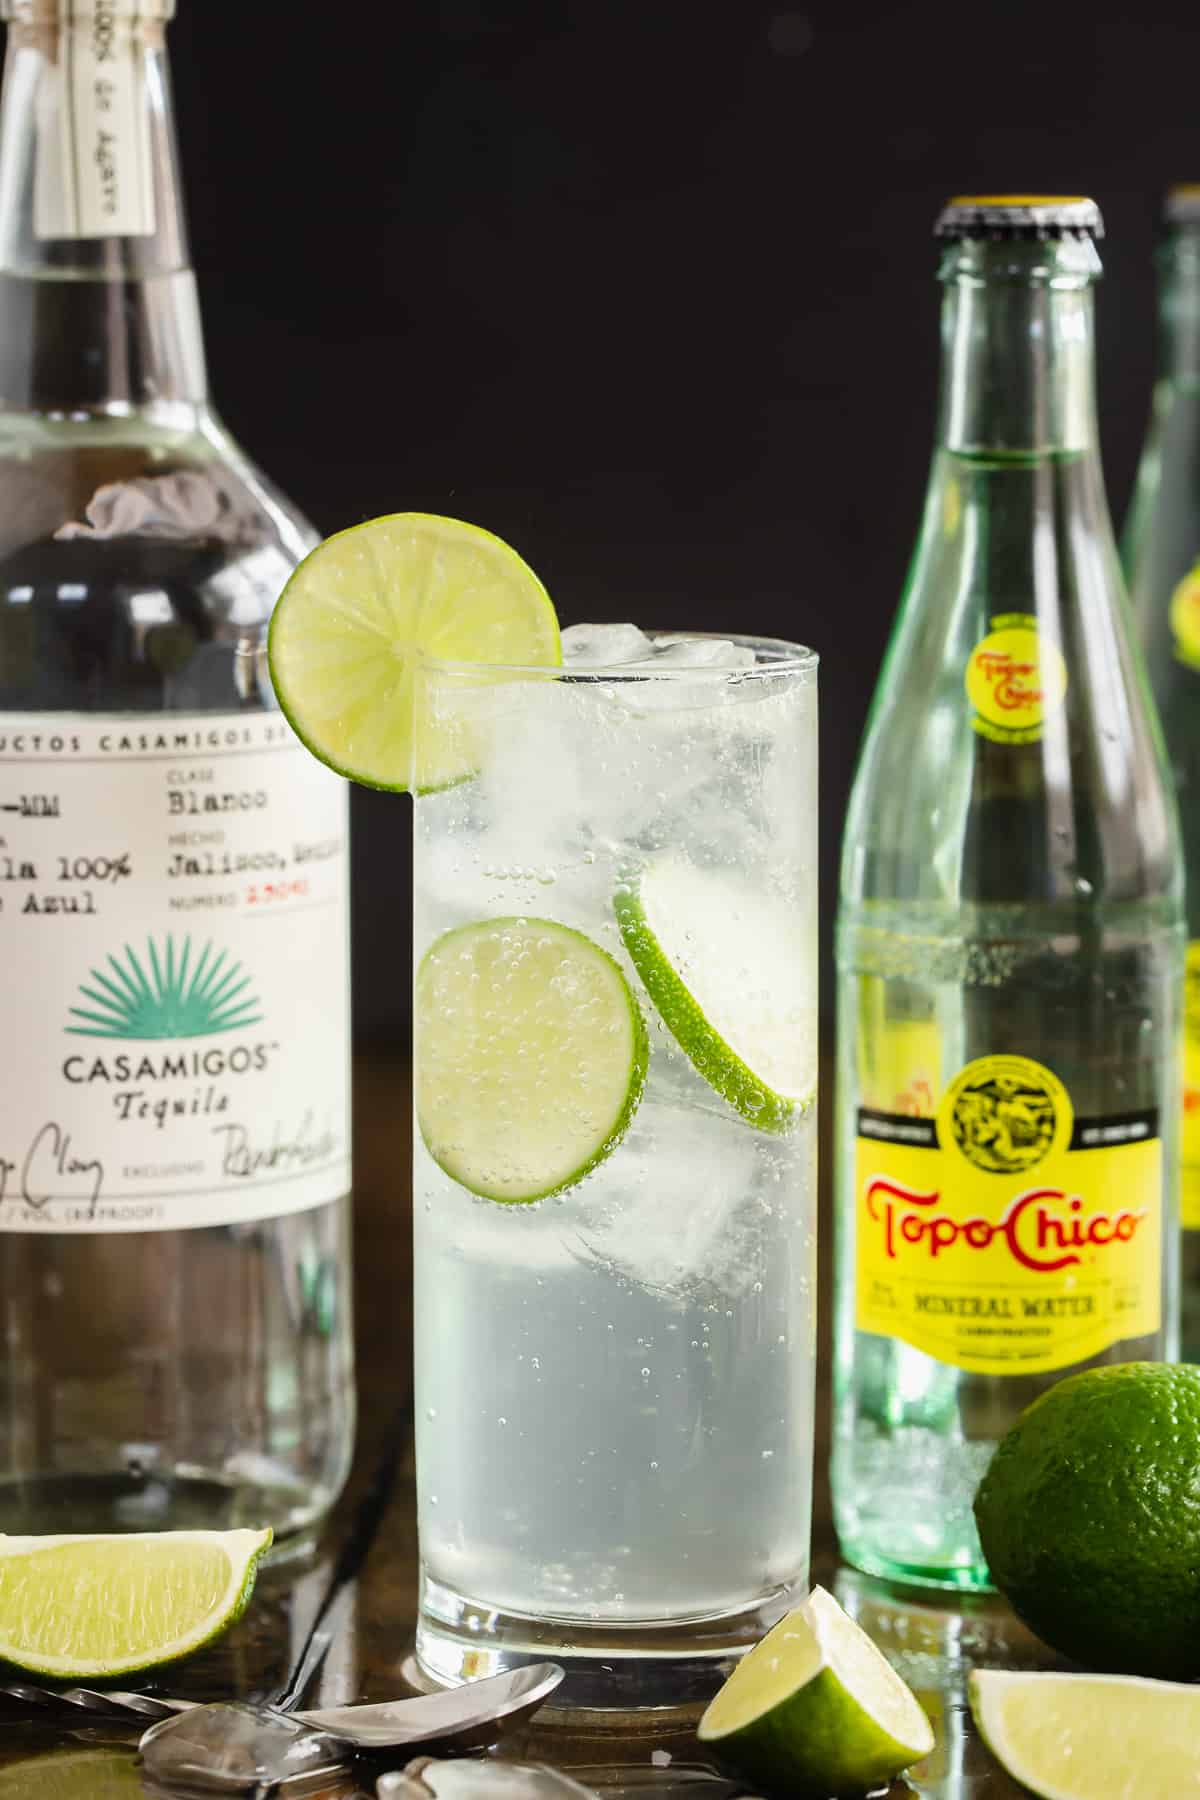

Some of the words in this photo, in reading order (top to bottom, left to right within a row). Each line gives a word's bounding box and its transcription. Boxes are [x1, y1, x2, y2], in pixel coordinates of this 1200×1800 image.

[99, 730, 250, 751] CASAMIGOS
[168, 789, 268, 815] Blanco
[57, 853, 132, 884] 100%
[168, 852, 286, 877] Jalisco,
[22, 891, 97, 914] Azul
[63, 1046, 269, 1083] CASAMIGOS
[114, 1086, 229, 1129] Tequila
[867, 1179, 994, 1258] Topo
[1003, 1188, 1146, 1272] Chico
[914, 1294, 1013, 1318] MINERAL
[1022, 1296, 1094, 1317] WATER
